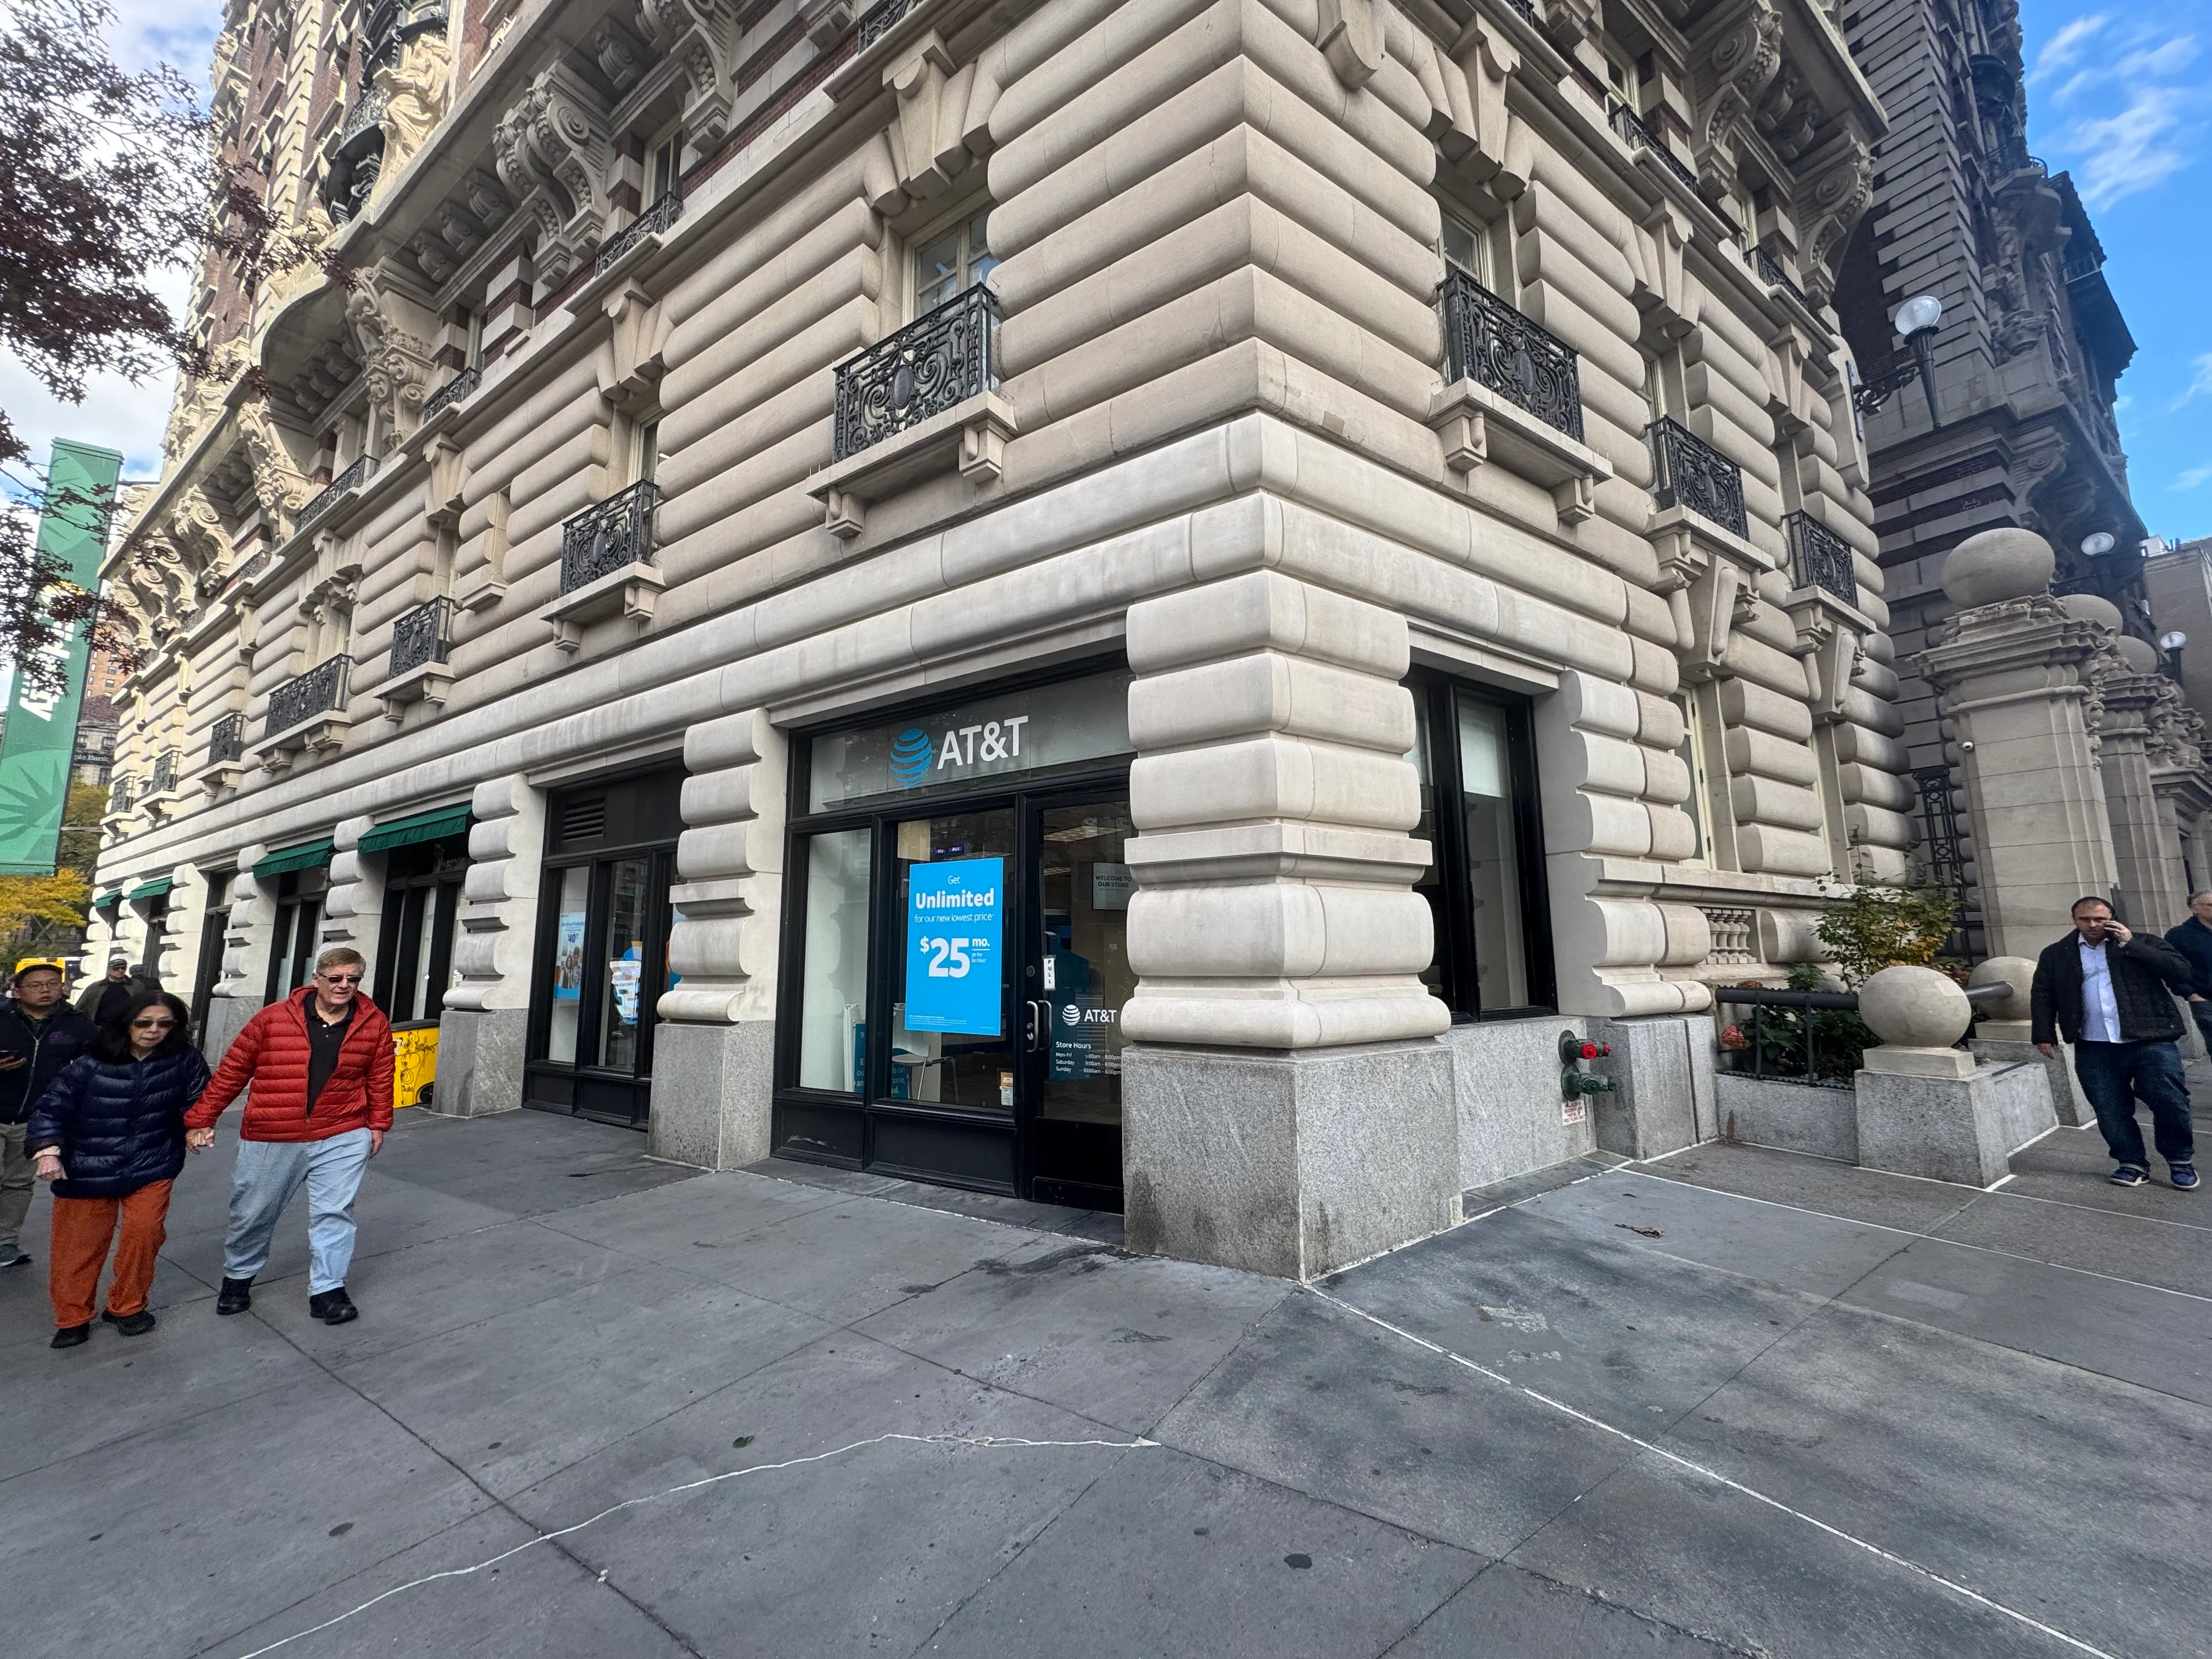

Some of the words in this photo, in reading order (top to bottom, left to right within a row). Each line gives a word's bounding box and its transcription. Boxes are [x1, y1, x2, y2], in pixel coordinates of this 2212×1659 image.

[937, 715, 1029, 770] AT&T
[947, 876, 961, 884] Get
[916, 888, 994, 909] Unlimited
[915, 913, 923, 923] for
[951, 913, 973, 922] lowest
[972, 938, 990, 947] mo.
[919, 935, 970, 978] $25
[1084, 1009, 1117, 1023] AT&T
